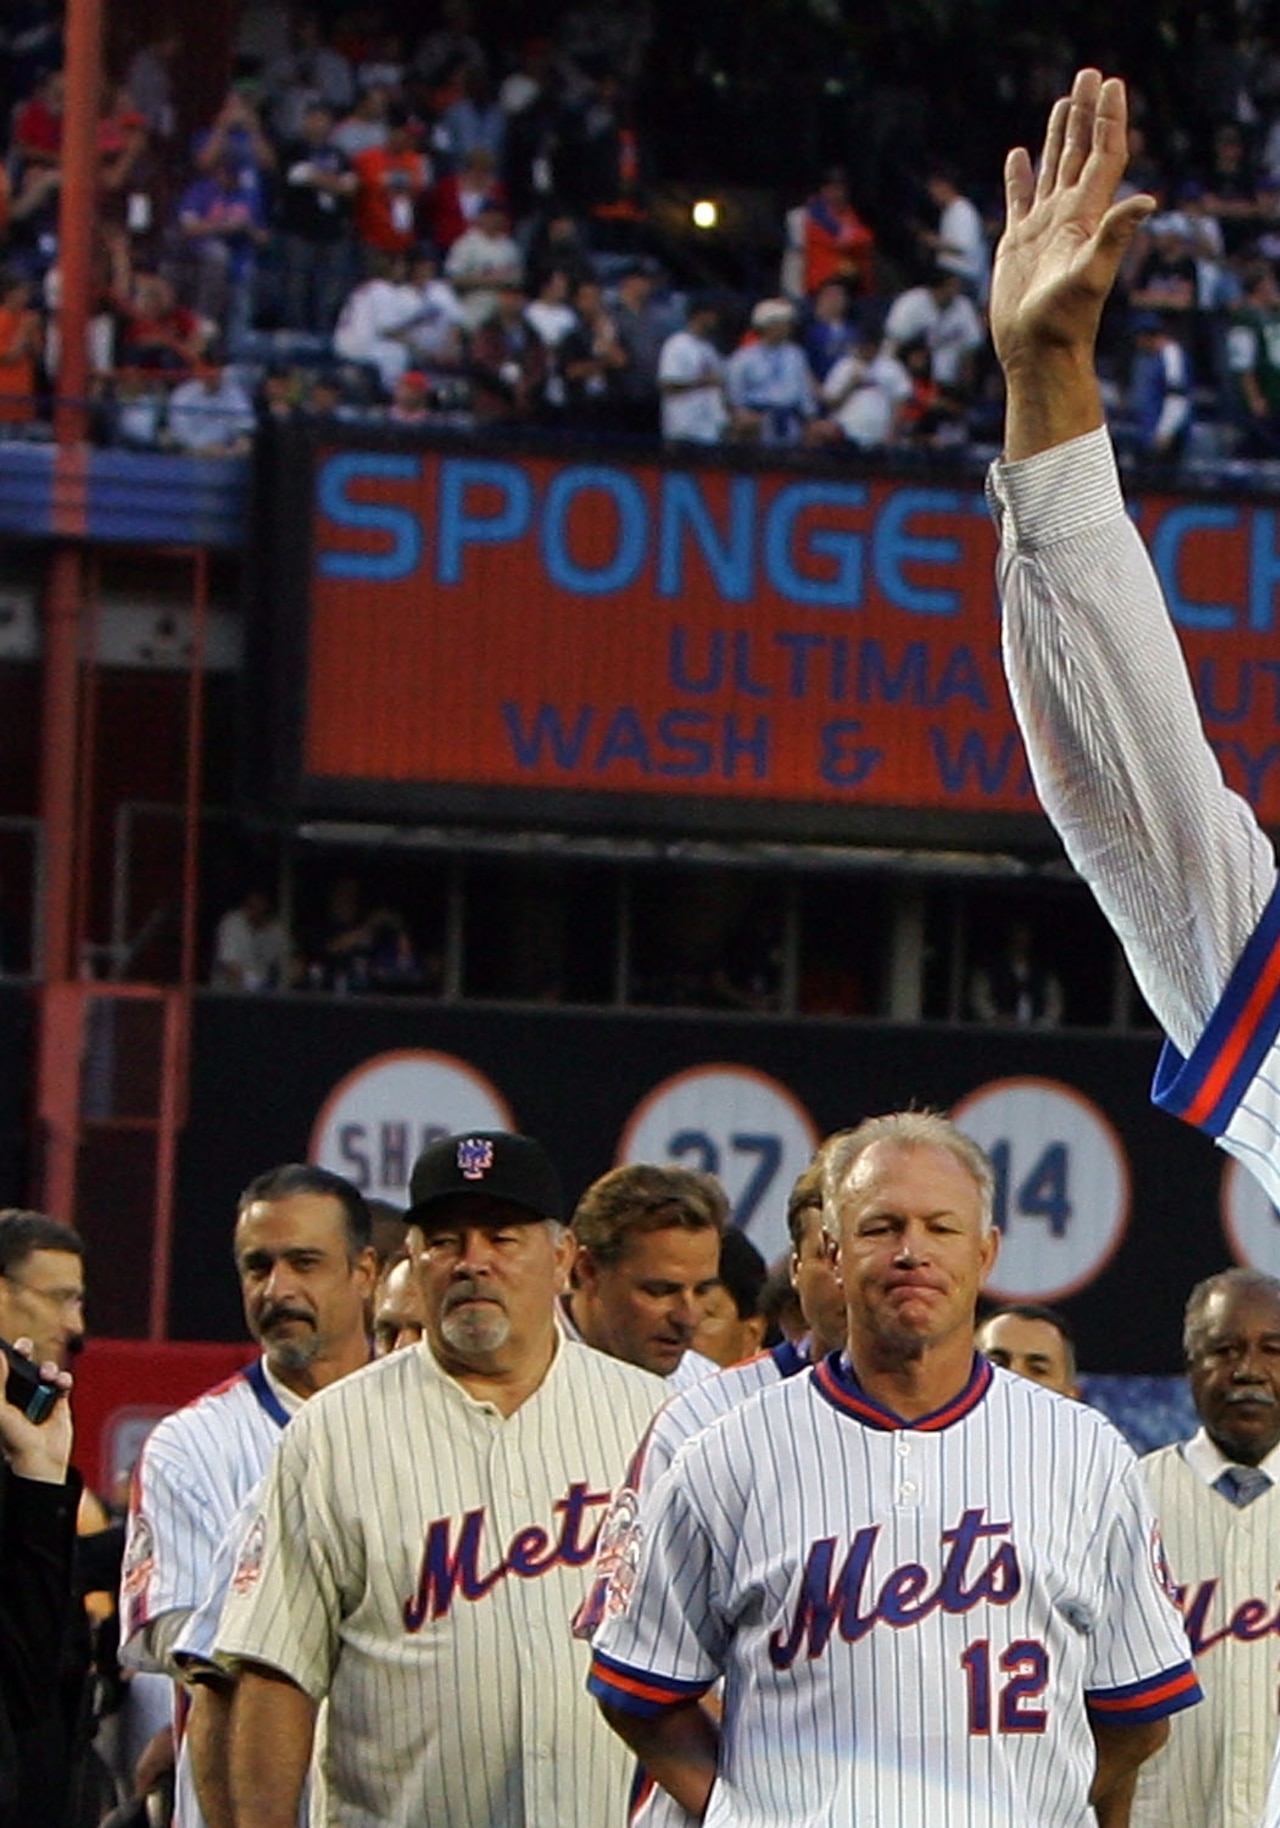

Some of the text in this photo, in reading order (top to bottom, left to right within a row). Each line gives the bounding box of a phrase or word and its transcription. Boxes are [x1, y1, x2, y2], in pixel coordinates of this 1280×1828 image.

[667, 626, 1004, 712] ULTIMA
[500, 701, 771, 780] WASH
[818, 721, 881, 788] &
[402, 1481, 612, 1634] Met
[768, 1506, 1022, 1671] Mets
[960, 1638, 1051, 1736] 12
